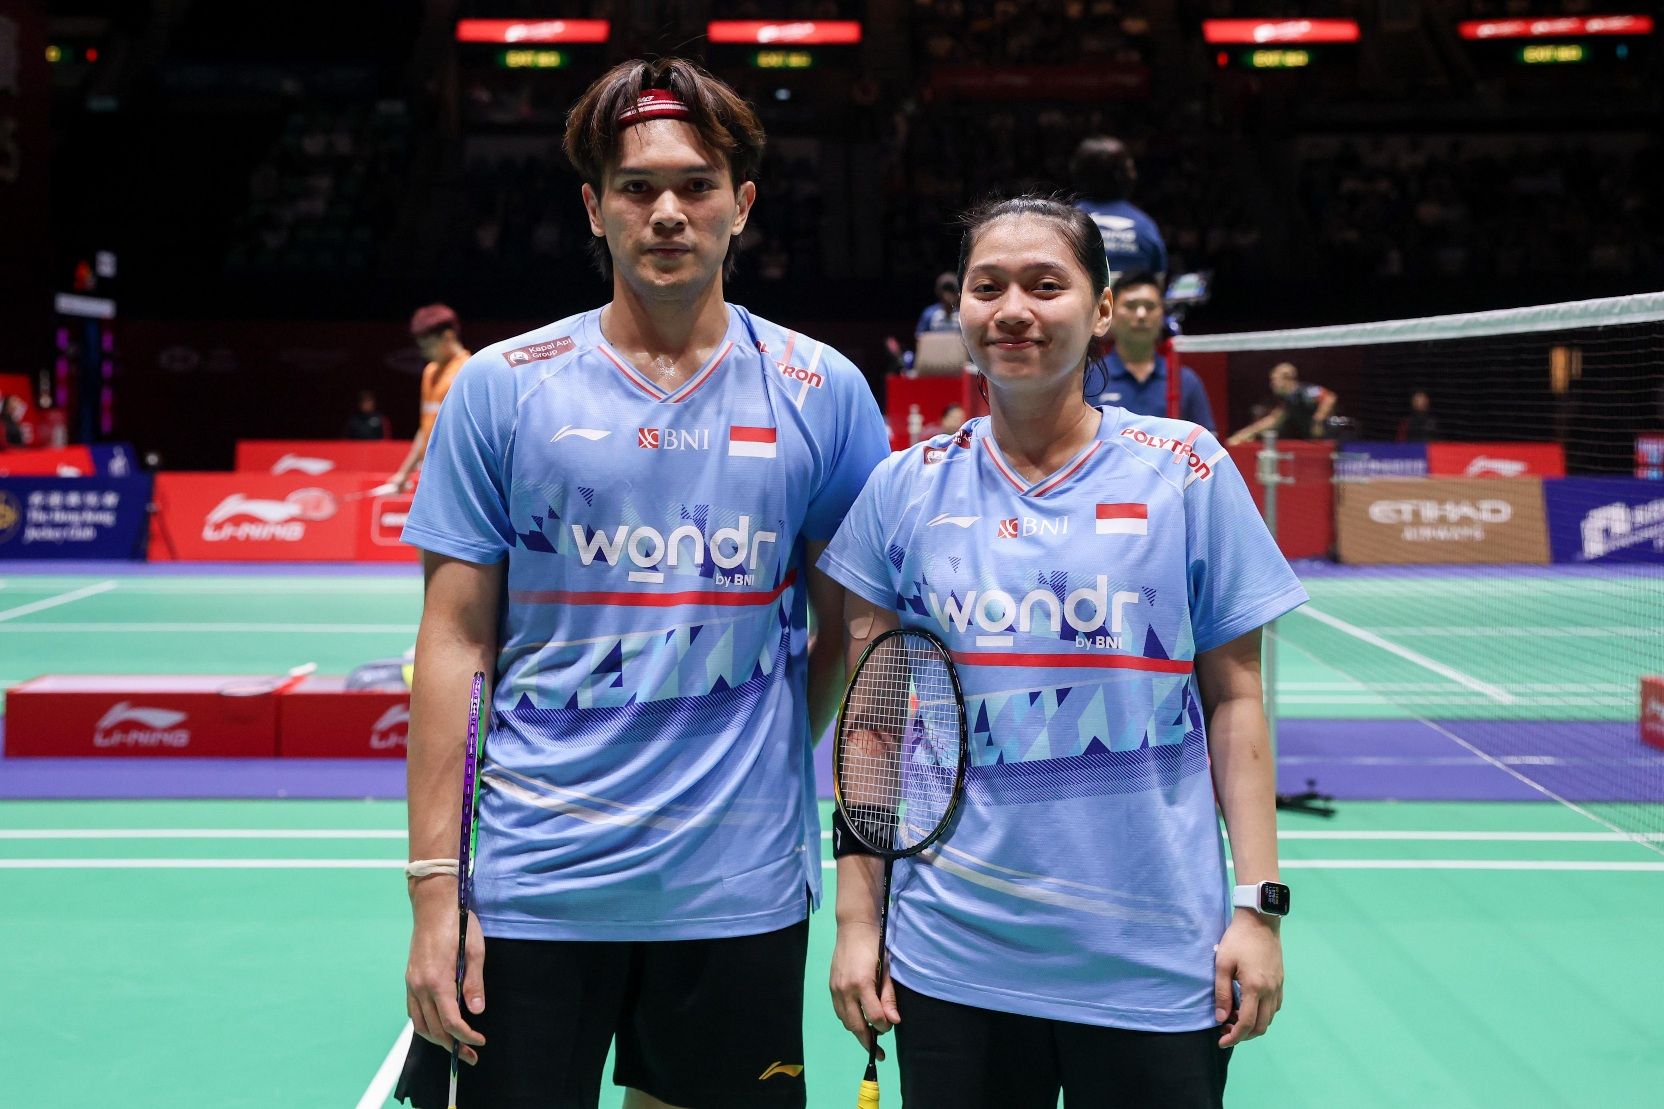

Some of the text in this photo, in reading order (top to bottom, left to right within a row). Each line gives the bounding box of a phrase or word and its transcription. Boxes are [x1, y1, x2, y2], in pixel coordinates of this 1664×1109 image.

[528, 342, 555, 354] Kapal
[532, 349, 558, 359] Group
[663, 428, 711, 451] BNI
[1120, 428, 1211, 480] POLYTRON
[1368, 499, 1511, 523] ETIHAD
[1023, 515, 1069, 537] BNI
[571, 515, 777, 570] wondr
[715, 573, 755, 588] by BNI
[928, 574, 1139, 633] wondr
[1075, 635, 1122, 651] by BNI
